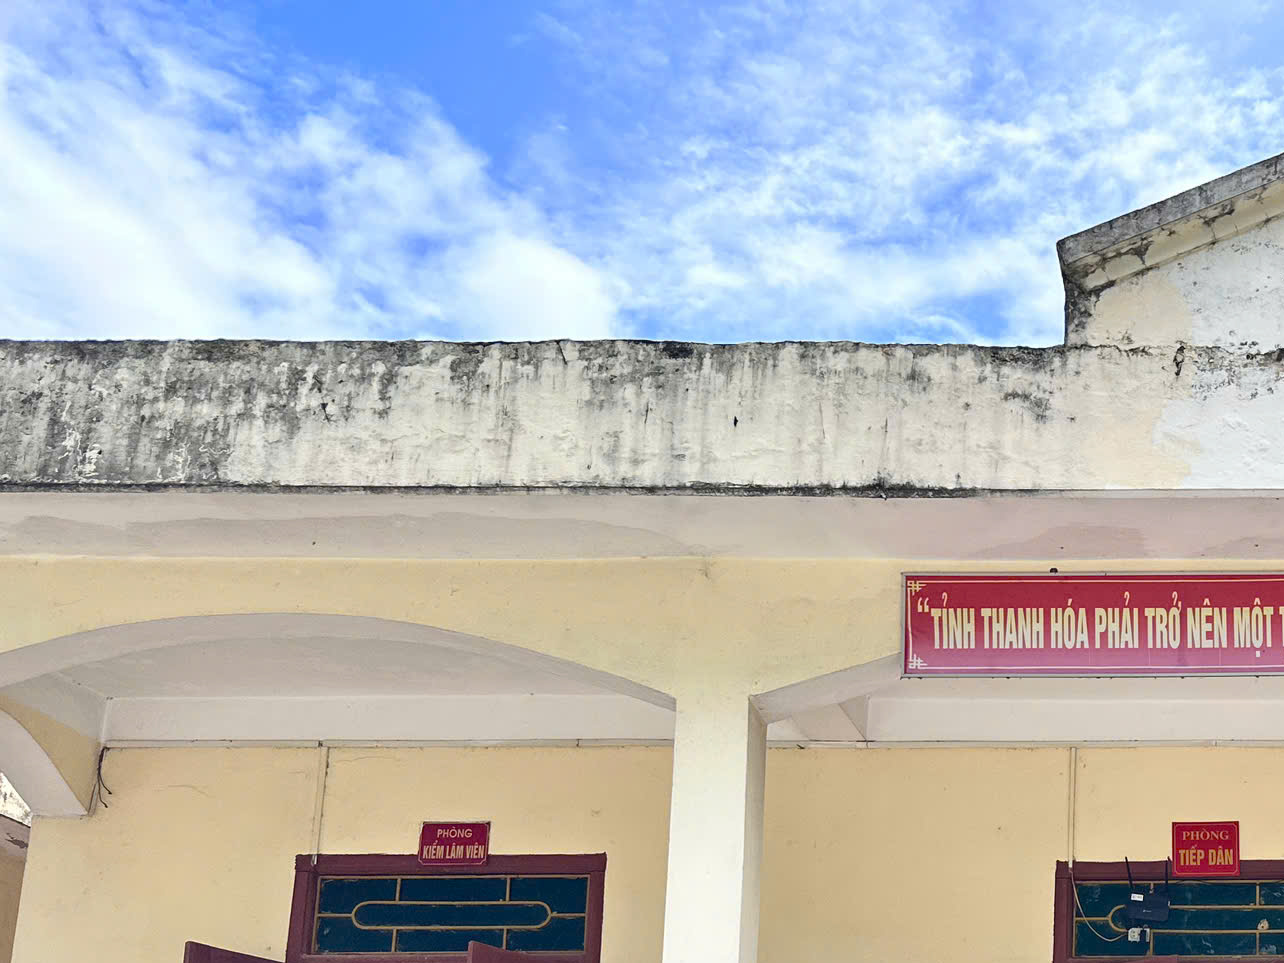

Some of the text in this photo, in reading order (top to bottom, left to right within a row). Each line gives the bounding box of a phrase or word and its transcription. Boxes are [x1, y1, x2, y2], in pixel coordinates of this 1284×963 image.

[980, 607, 1045, 649] THANH
[1050, 598, 1090, 649] HÓA
[1094, 591, 1140, 649] PHẢI
[1144, 591, 1182, 649] TRỞ
[1186, 597, 1228, 649] NÊN
[1233, 597, 1274, 658] MỘT
[436, 826, 473, 838] PHÒNG
[1182, 828, 1229, 841] PHÒNG
[422, 840, 485, 859] KIỂM LÂM VIÊN
[1178, 844, 1234, 866] TIẾP DÂN
